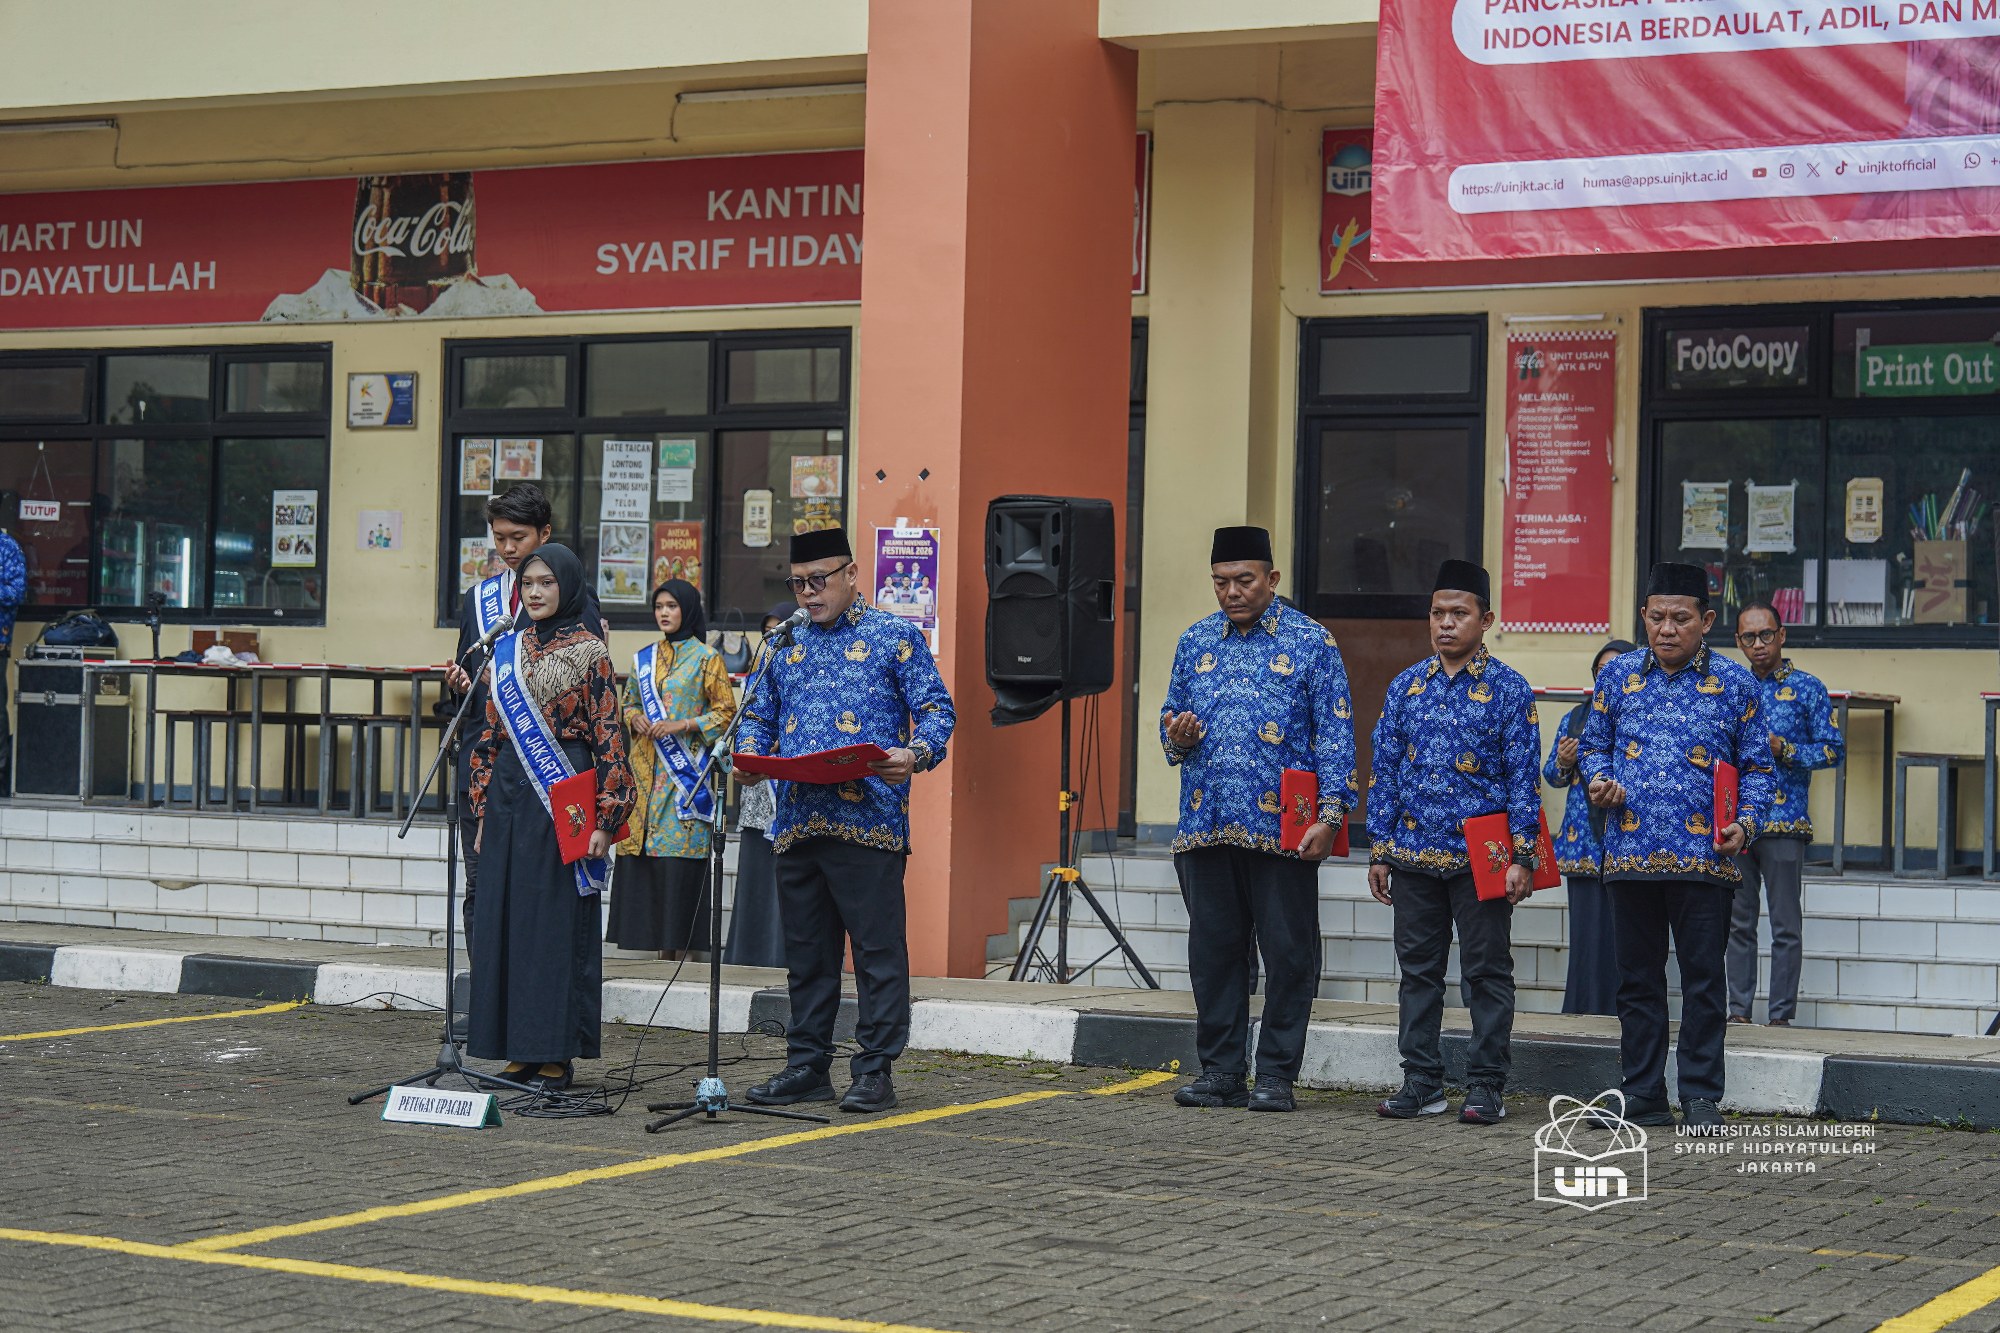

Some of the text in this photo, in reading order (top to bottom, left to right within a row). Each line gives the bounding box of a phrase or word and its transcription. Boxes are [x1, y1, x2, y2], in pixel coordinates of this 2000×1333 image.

[1484, 21, 1632, 50] INDONESIA
[1641, 10, 1810, 41] BERDAULAT,
[1819, 5, 1889, 31] ADIL,
[1899, 0, 1962, 25] DAN
[1462, 178, 1564, 196] https://uinjkt.ac.id
[1583, 170, 1728, 189] humas@apps.uinjkt.ac.id
[1859, 158, 1936, 176] uinjktofficial
[707, 183, 861, 221] KANTIN
[86, 219, 142, 249] UIN
[354, 199, 474, 257] Coca-Cola
[596, 233, 864, 275] SYARIF HIDAY
[1550, 351, 1610, 361] UNIT USAHA
[1677, 334, 1799, 376] FotoCopy
[1557, 363, 1577, 371] ATK
[1588, 362, 1602, 370] PU
[1866, 352, 1994, 386] Print Out
[1518, 393, 1569, 402] MELAYANI
[606, 443, 623, 452] SATE
[612, 460, 643, 468] LONTONG
[630, 472, 644, 480] RIBU
[24, 505, 57, 516] TUTUP
[1514, 514, 1553, 523] TERIMA
[1555, 514, 1581, 523] JASA
[667, 528, 690, 537] ANEKA
[661, 538, 697, 550] DIMSUM
[882, 546, 934, 556] FESTIVAL 2026
[485, 597, 500, 625] DUTA
[501, 680, 565, 784] DUTA UIN JAKARTA
